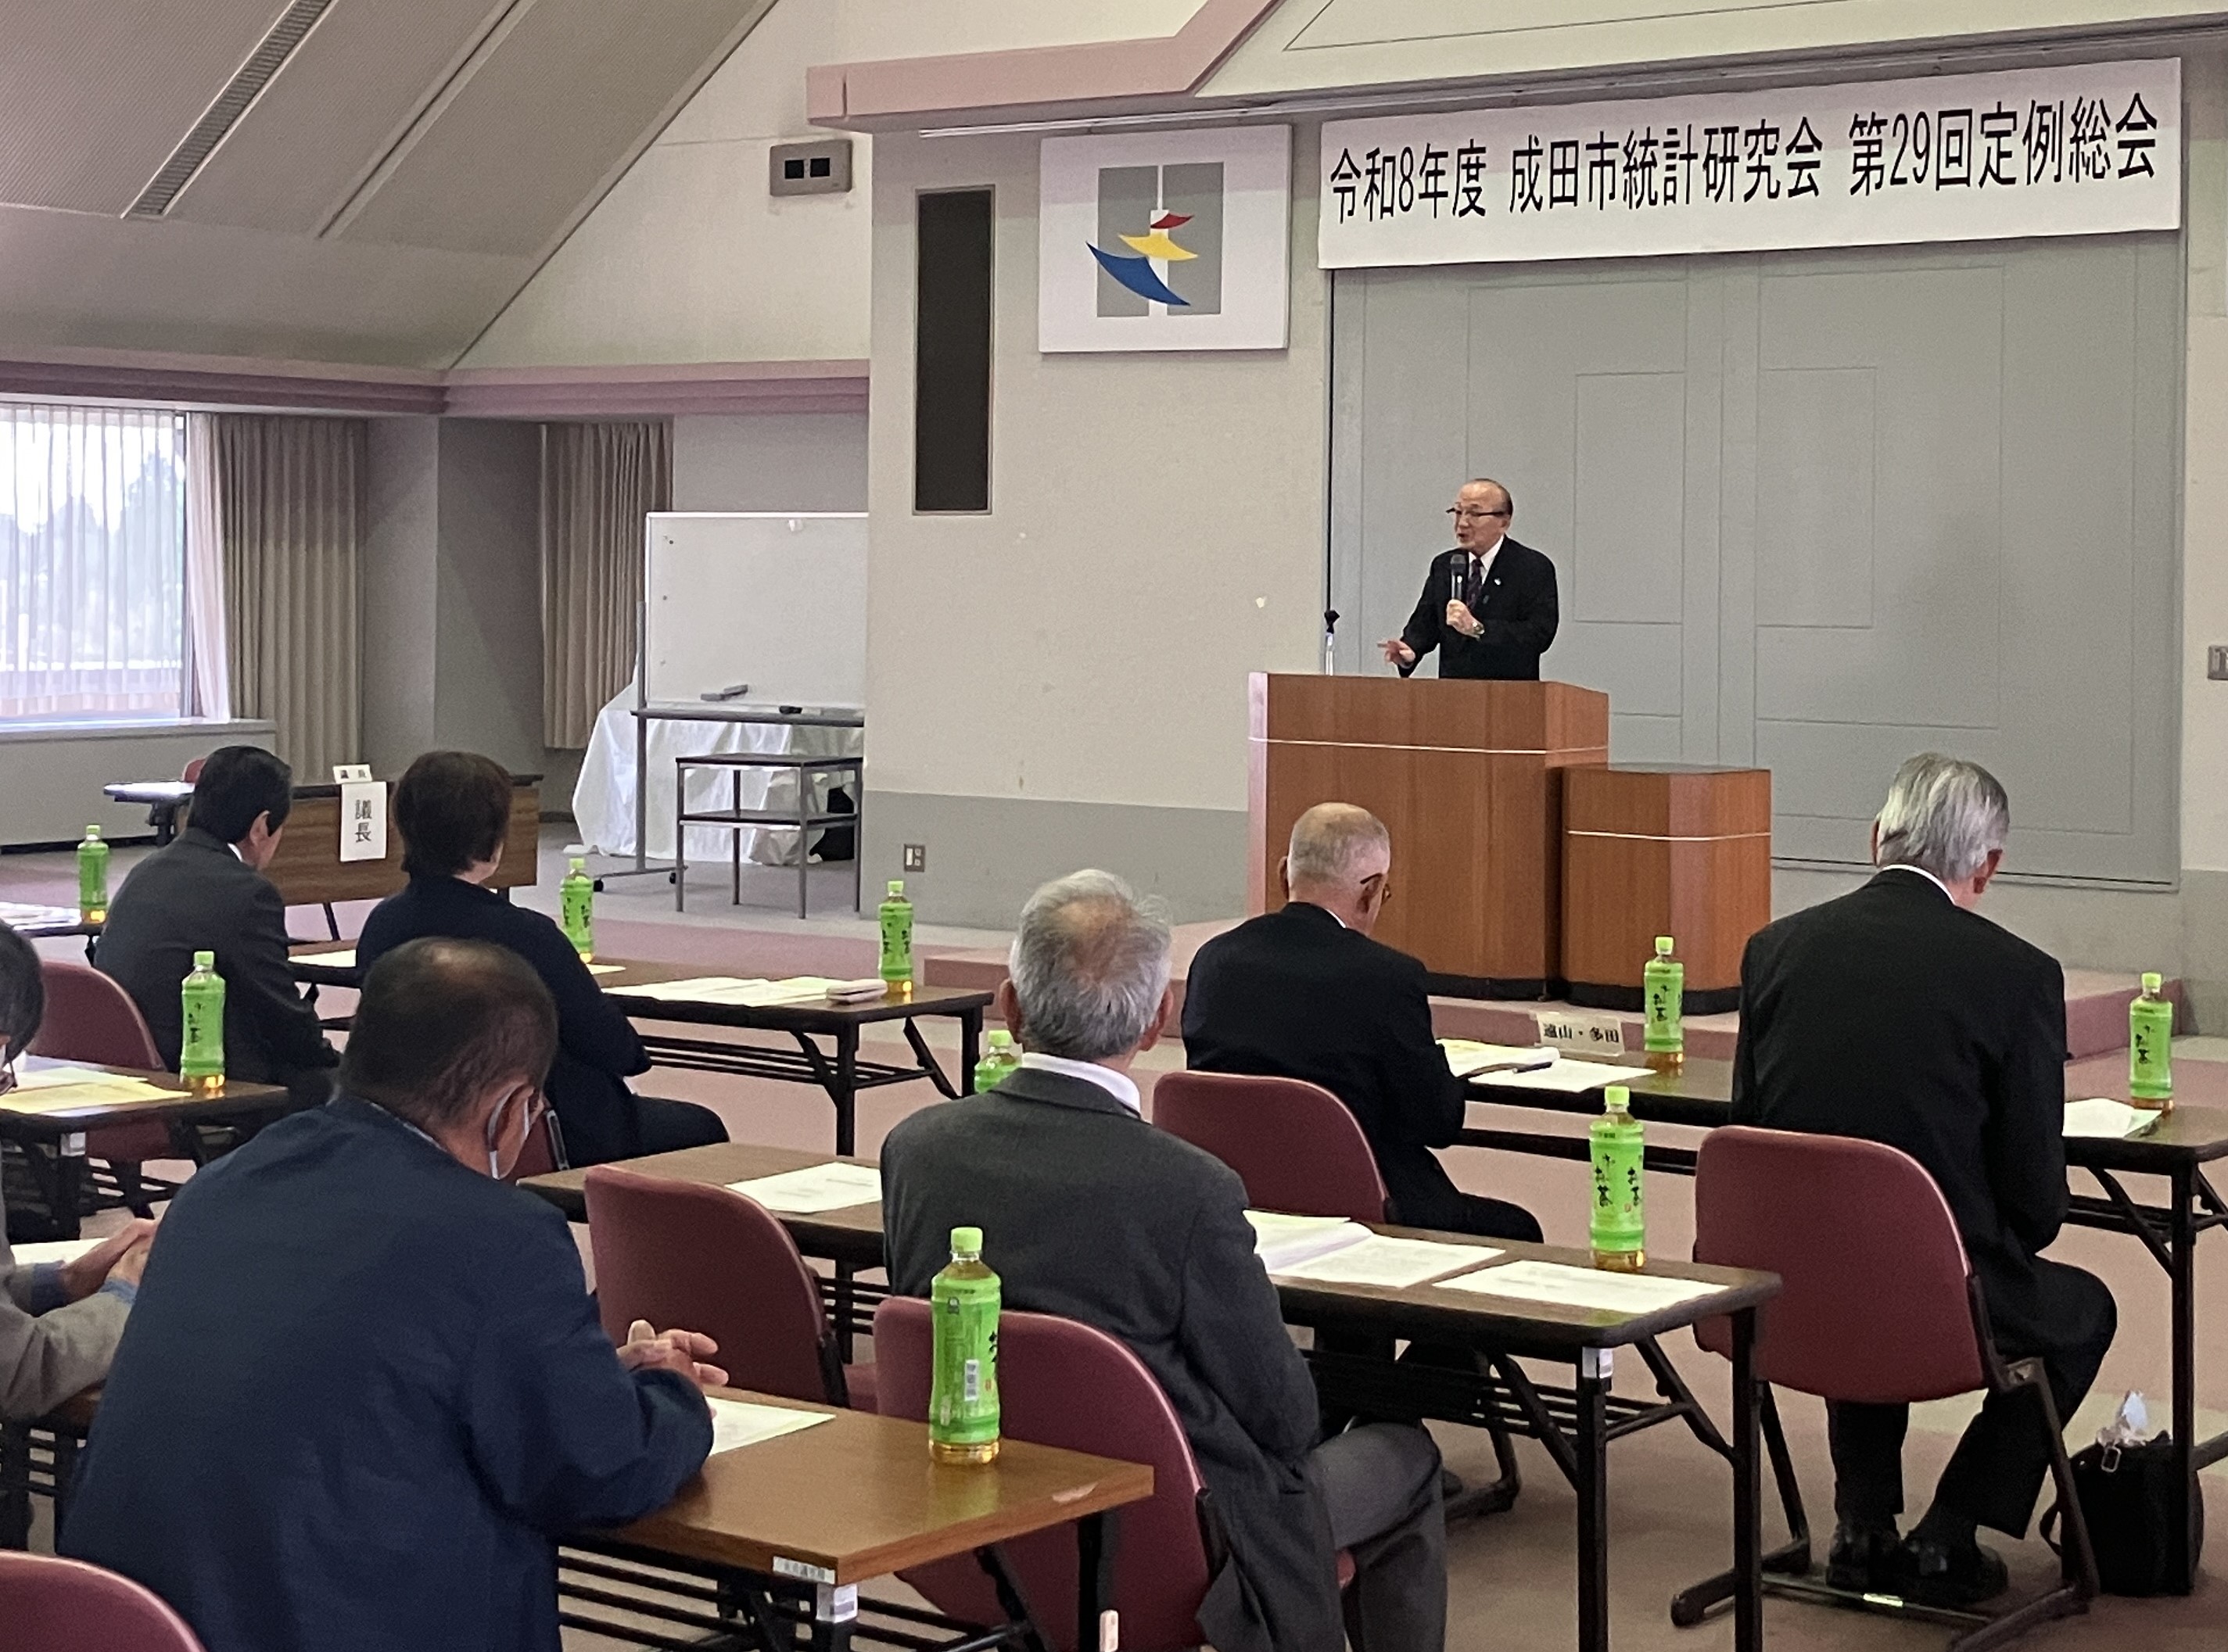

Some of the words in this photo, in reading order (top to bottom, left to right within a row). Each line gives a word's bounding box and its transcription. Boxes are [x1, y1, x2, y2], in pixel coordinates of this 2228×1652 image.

[1330, 138, 1487, 224] 令和8年度
[1509, 116, 1824, 213] 成田市統計研究会
[1849, 92, 2158, 197] 第29回定例総会
[354, 798, 373, 844] 議長
